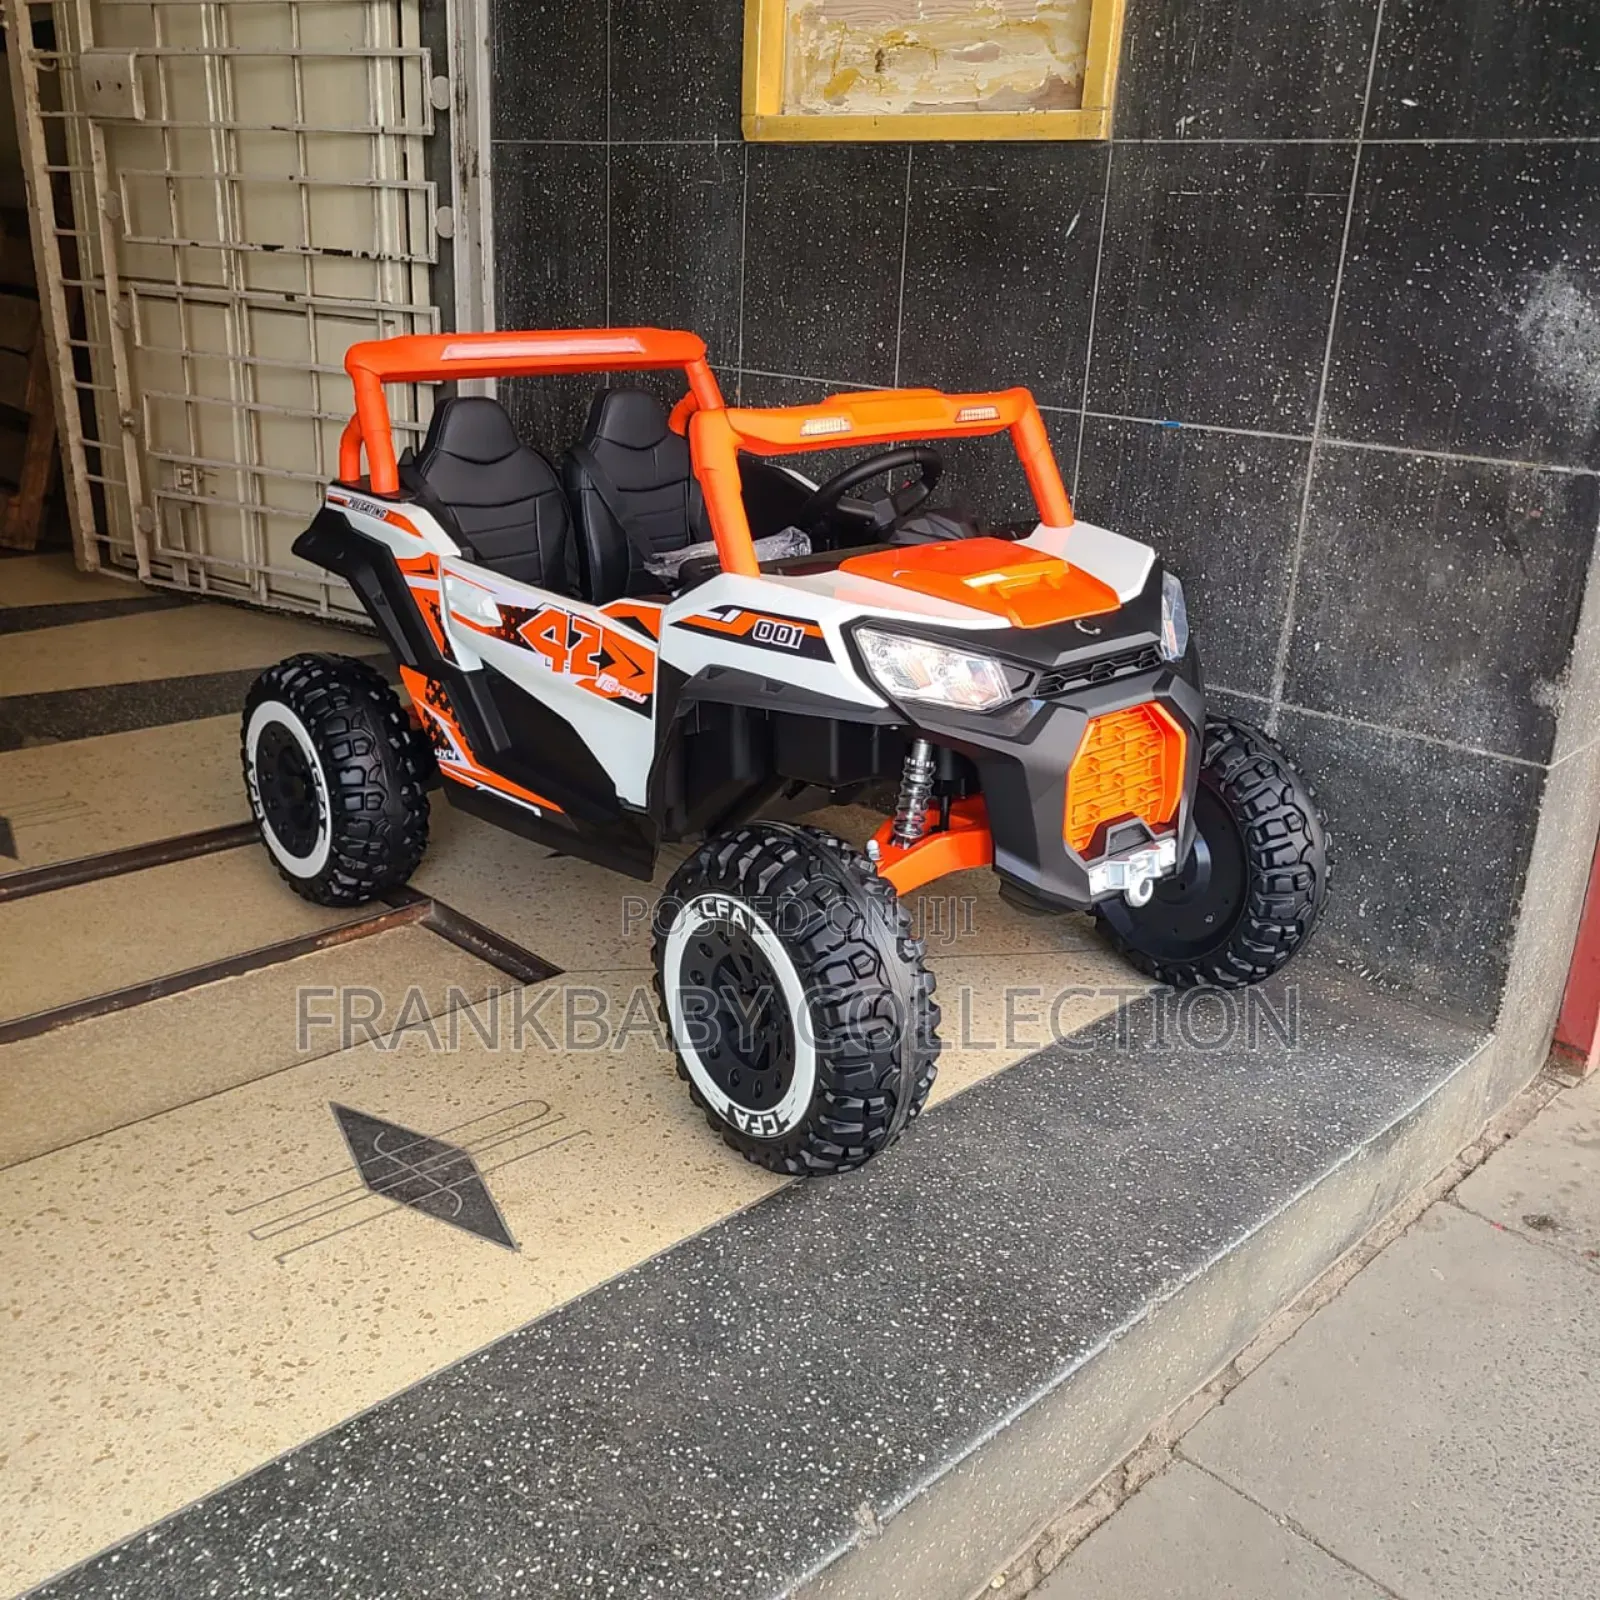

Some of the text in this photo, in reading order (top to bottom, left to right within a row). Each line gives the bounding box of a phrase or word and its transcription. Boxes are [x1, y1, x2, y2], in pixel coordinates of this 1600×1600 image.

[348, 497, 388, 518] PULSATING
[753, 619, 805, 649] 001
[701, 898, 747, 931] CFA
